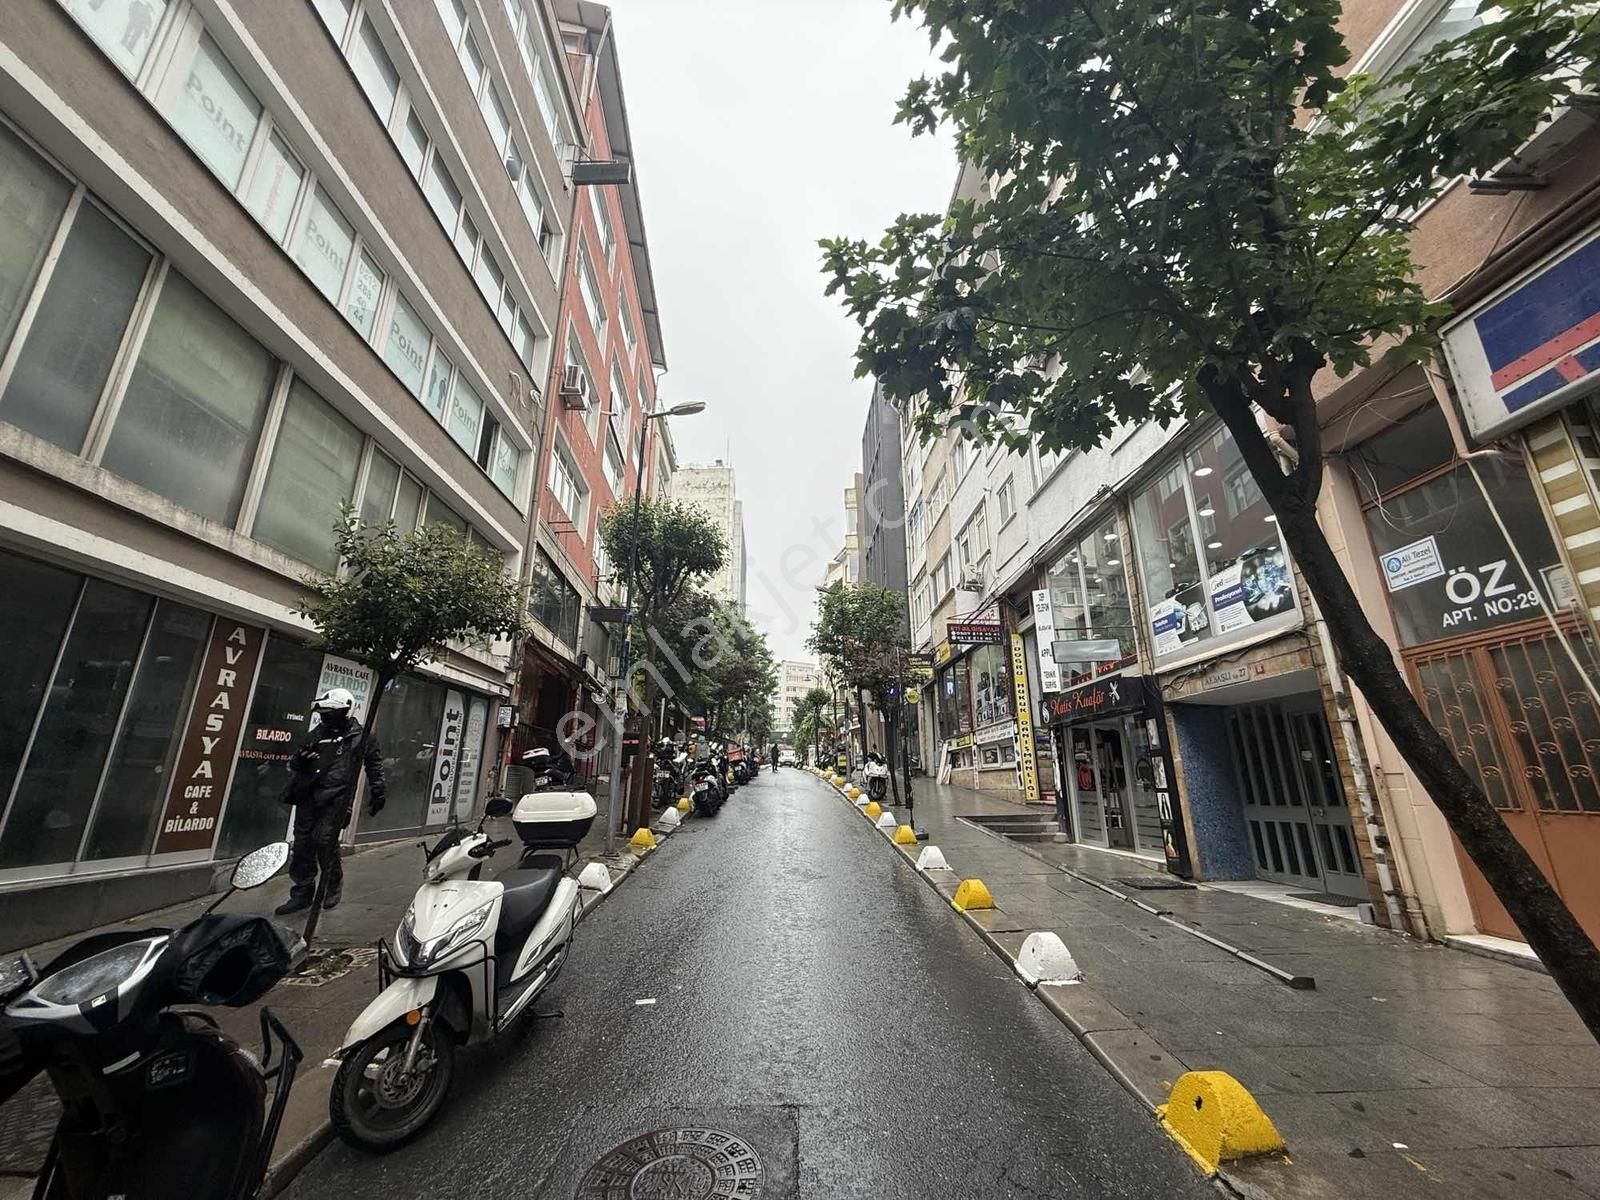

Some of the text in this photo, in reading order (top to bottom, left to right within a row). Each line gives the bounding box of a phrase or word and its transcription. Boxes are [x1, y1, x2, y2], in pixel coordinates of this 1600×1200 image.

[186, 69, 247, 153] Point
[305, 218, 345, 272] Point
[391, 320, 424, 370] Point
[453, 396, 476, 432] Point
[1411, 545, 1432, 558] Tezel
[1445, 558, 1516, 605] ÖZ
[1442, 590, 1540, 628] APT. NO:29
[191, 626, 247, 779] AVRASYA
[1072, 686, 1105, 713] Kuaför
[431, 708, 460, 804] Point
[184, 785, 214, 799] CAFE
[189, 802, 199, 815] &
[164, 815, 215, 833] BİLARDO
